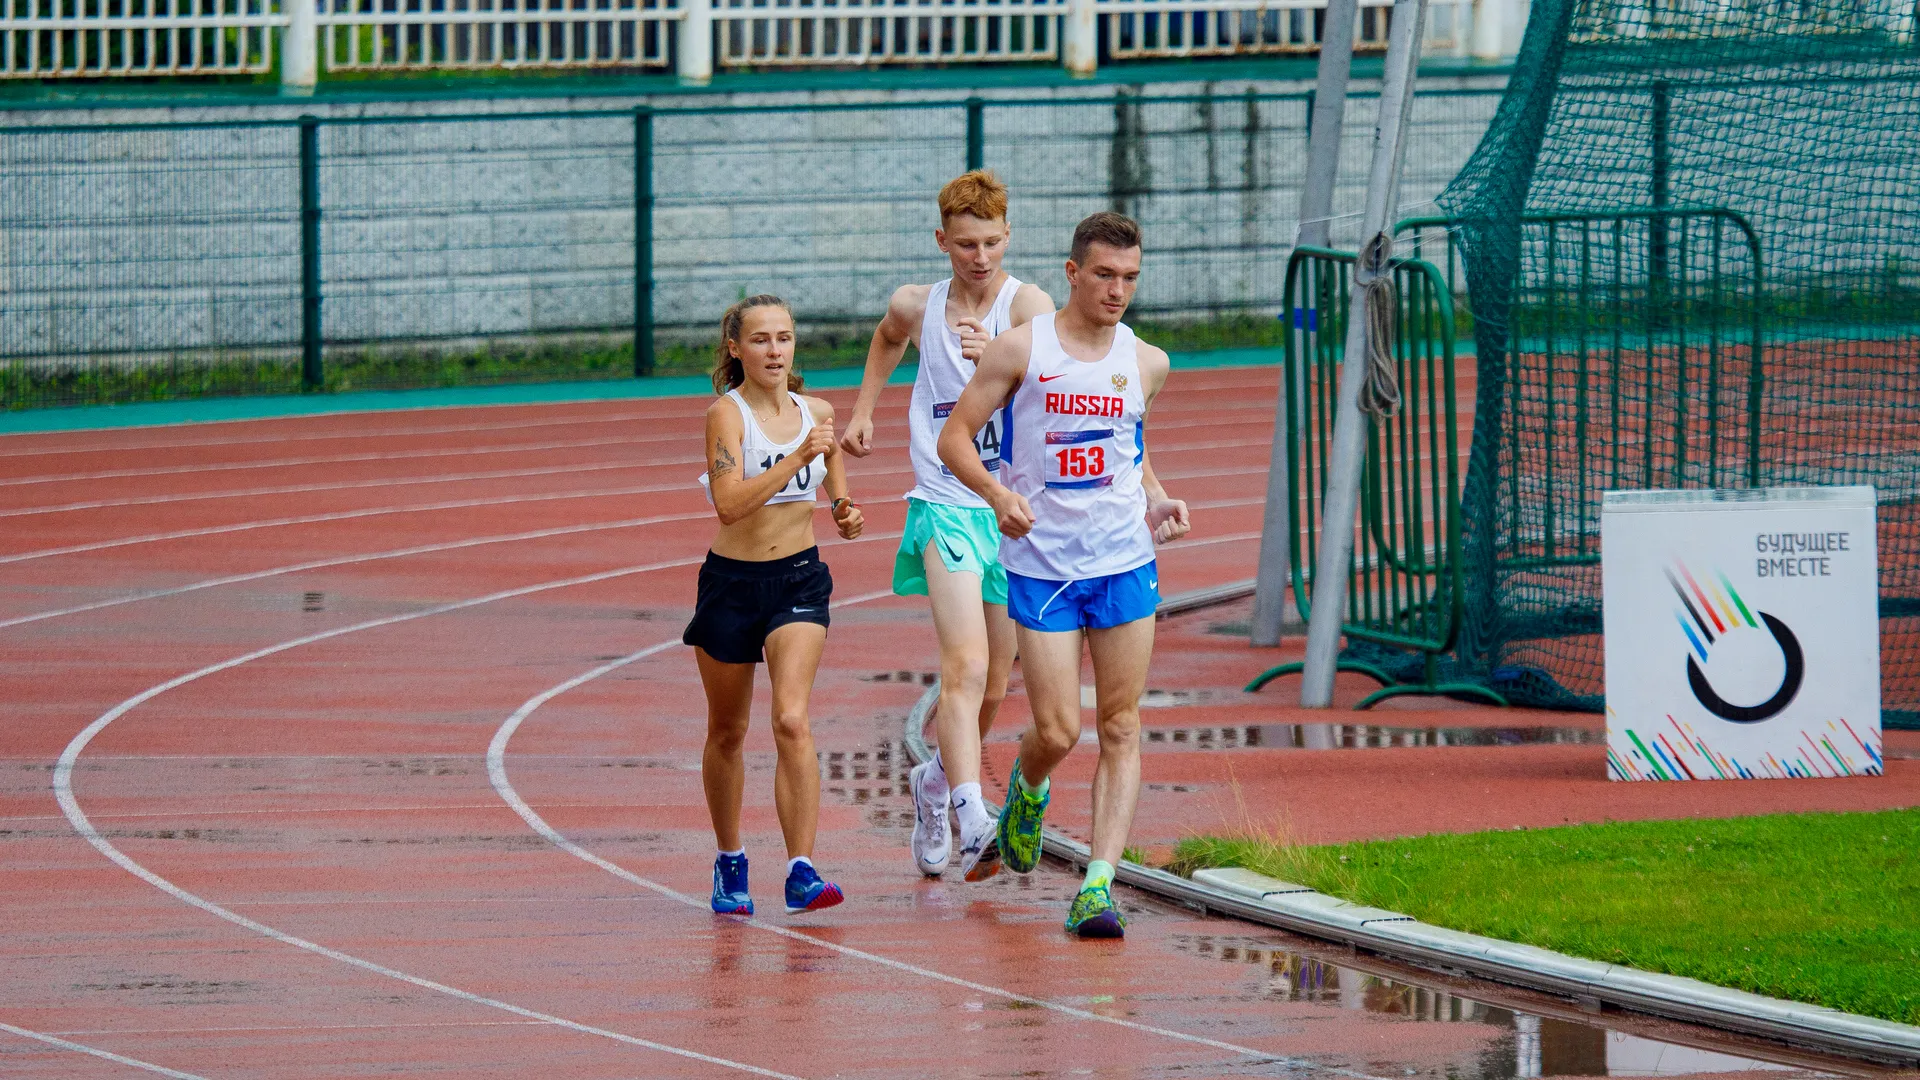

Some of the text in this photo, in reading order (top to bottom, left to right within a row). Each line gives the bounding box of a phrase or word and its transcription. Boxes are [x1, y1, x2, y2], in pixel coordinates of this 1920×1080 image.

[1045, 392, 1124, 418] RUSSIA
[1055, 446, 1105, 477] 153
[1756, 532, 1850, 556] БУДУЩЕЕ
[1757, 557, 1831, 578] ВМЕСТЕ
